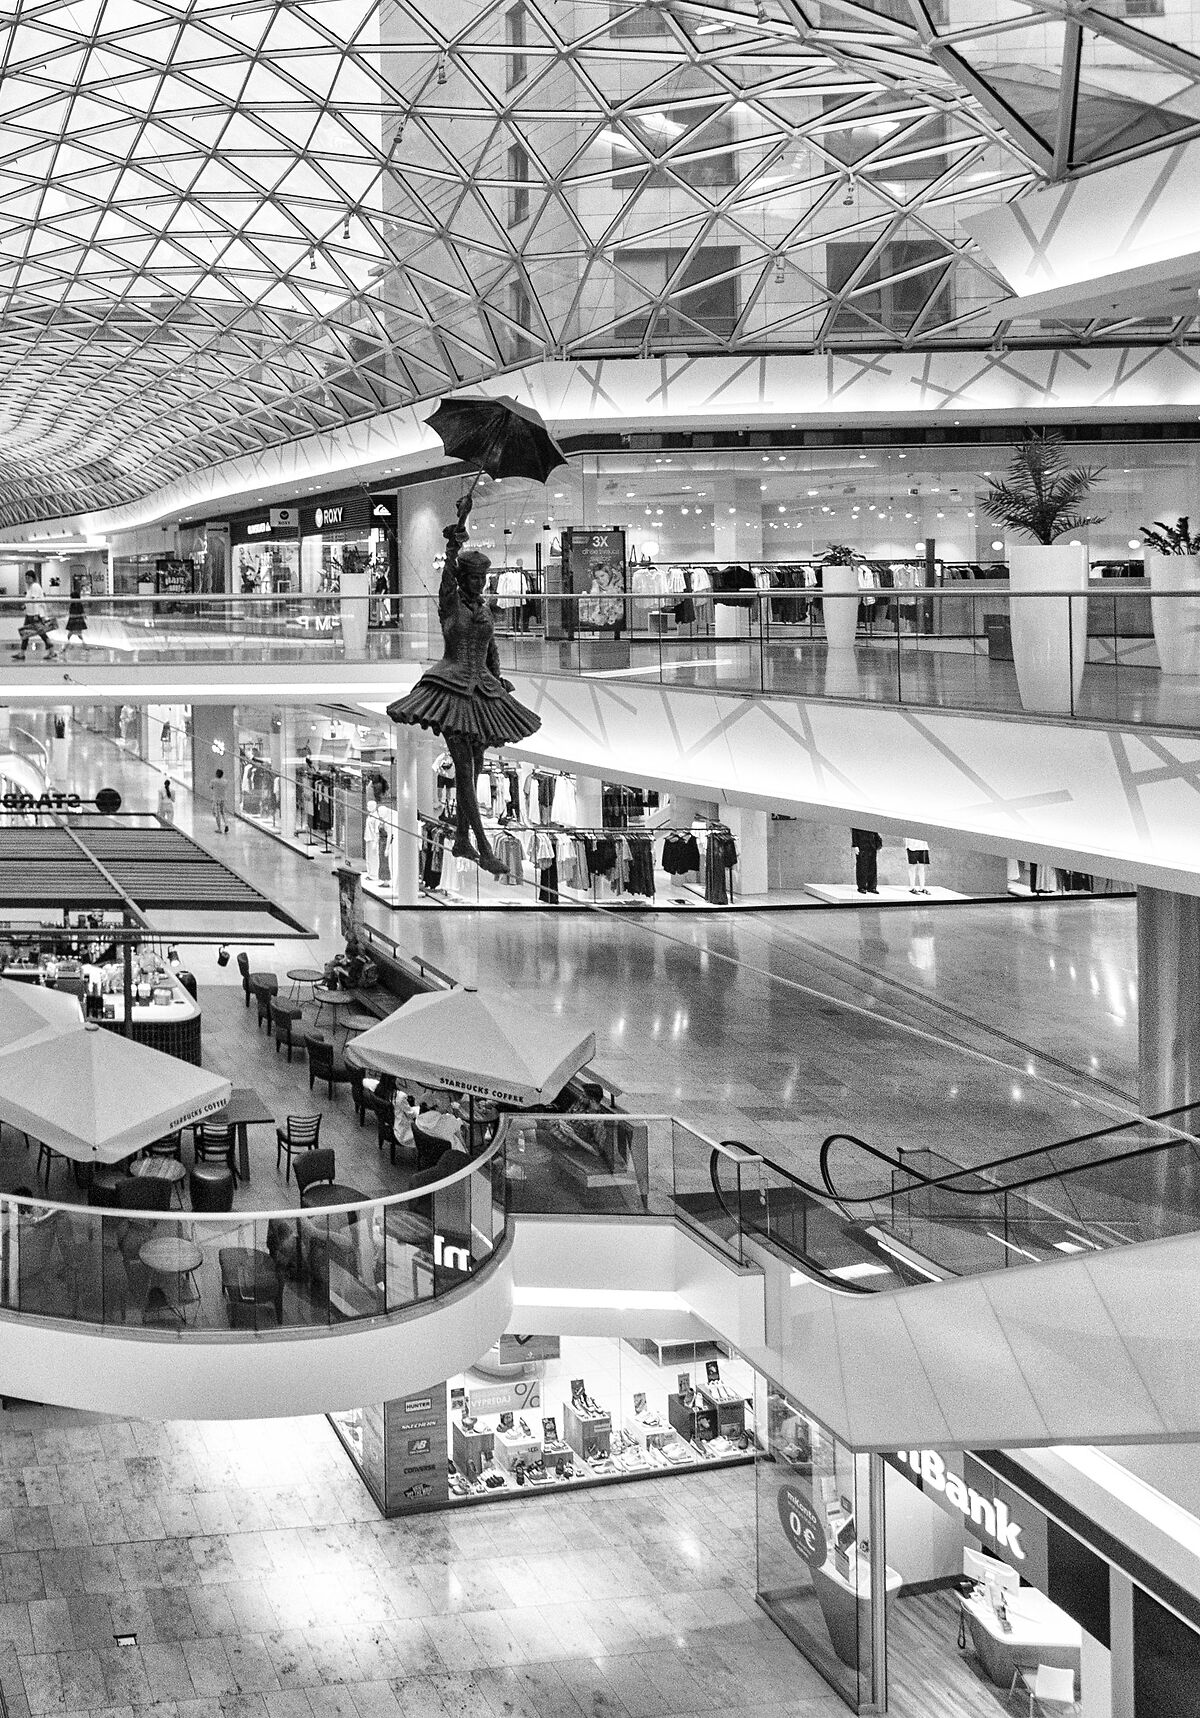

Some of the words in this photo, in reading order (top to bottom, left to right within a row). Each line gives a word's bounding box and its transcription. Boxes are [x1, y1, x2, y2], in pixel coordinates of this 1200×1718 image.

[323, 507, 344, 524] ROXY
[440, 1077, 489, 1095] STARBUCKS
[491, 1090, 524, 1103] COFFEE
[406, 1401, 430, 1410] HUNTER
